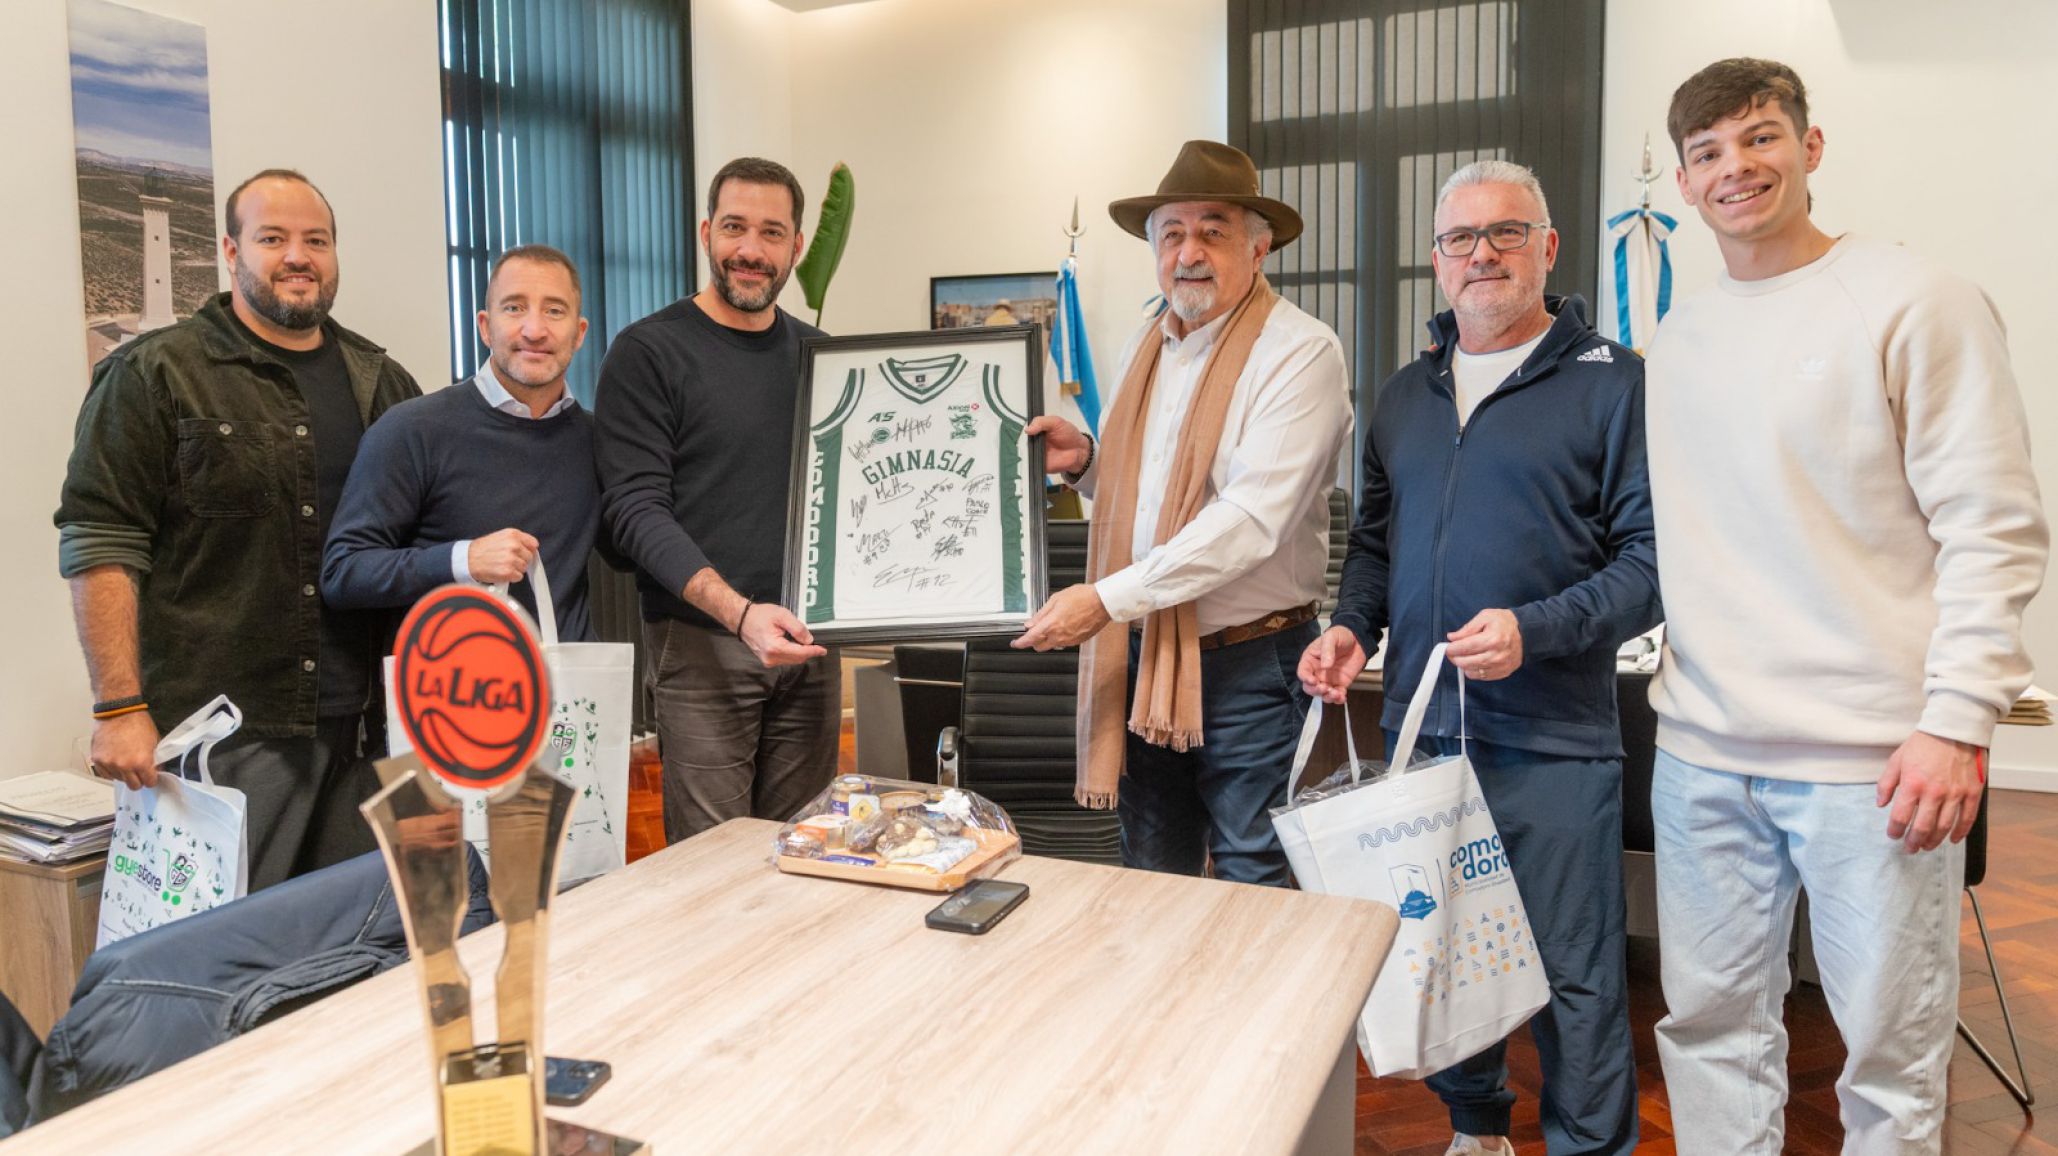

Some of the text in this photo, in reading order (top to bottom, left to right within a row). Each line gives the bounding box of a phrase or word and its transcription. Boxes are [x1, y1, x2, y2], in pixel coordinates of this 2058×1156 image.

[1577, 354, 1614, 363] adidas
[866, 411, 897, 423] AS
[861, 449, 976, 485] GIMNASIA
[417, 667, 525, 713] LA LIGA
